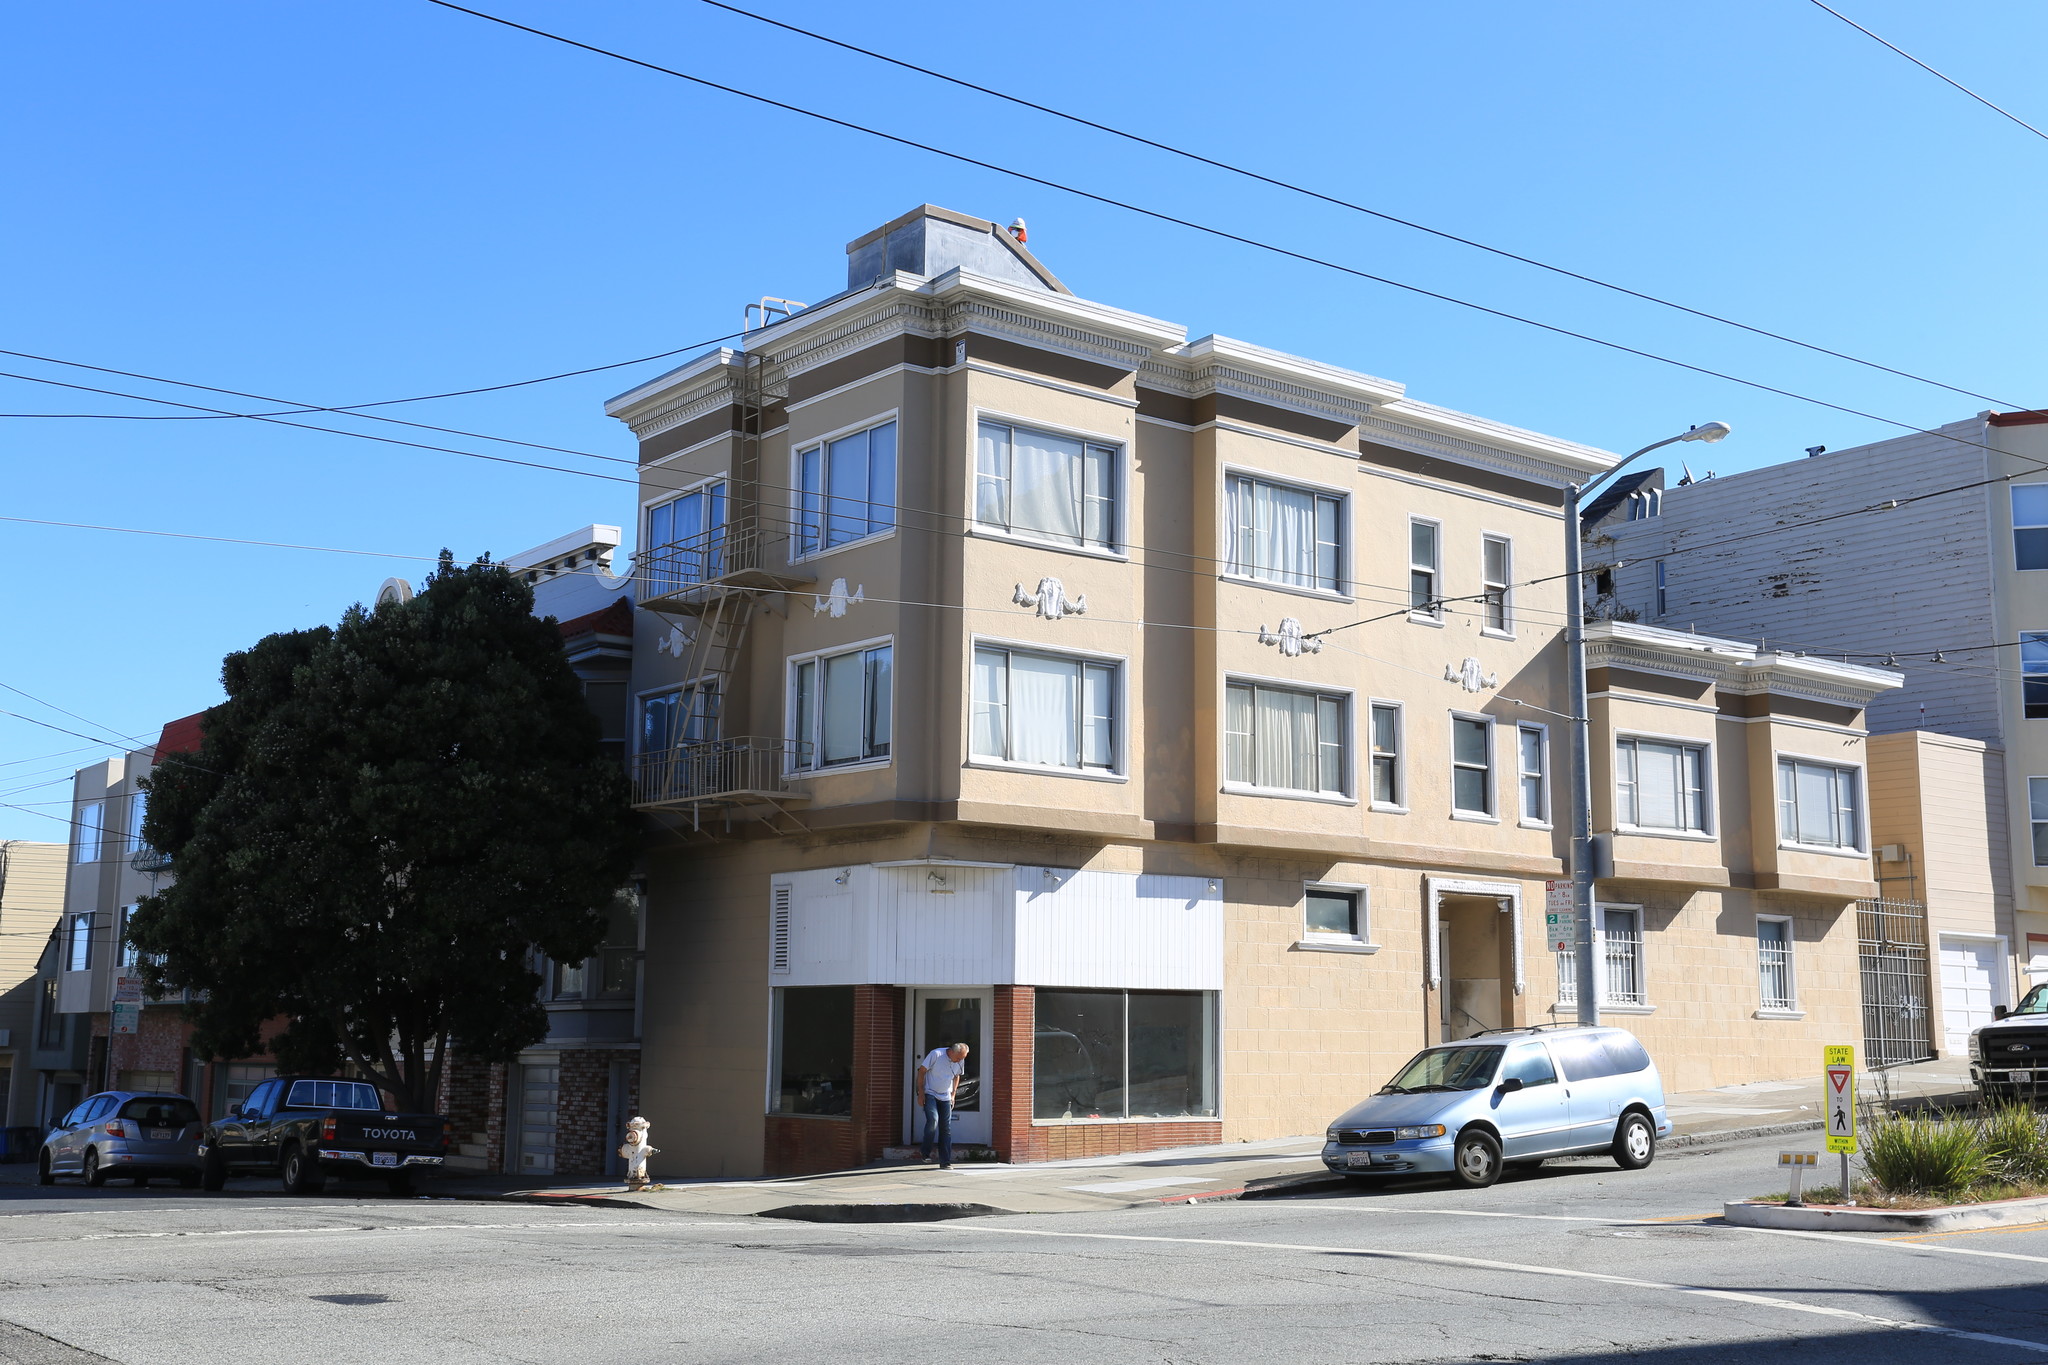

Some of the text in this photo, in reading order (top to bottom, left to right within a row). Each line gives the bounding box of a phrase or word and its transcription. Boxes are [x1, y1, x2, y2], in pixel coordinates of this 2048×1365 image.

[1547, 881, 1554, 890] NO
[1549, 915, 1556, 923] 2
[362, 1128, 416, 1141] TOYOTA
